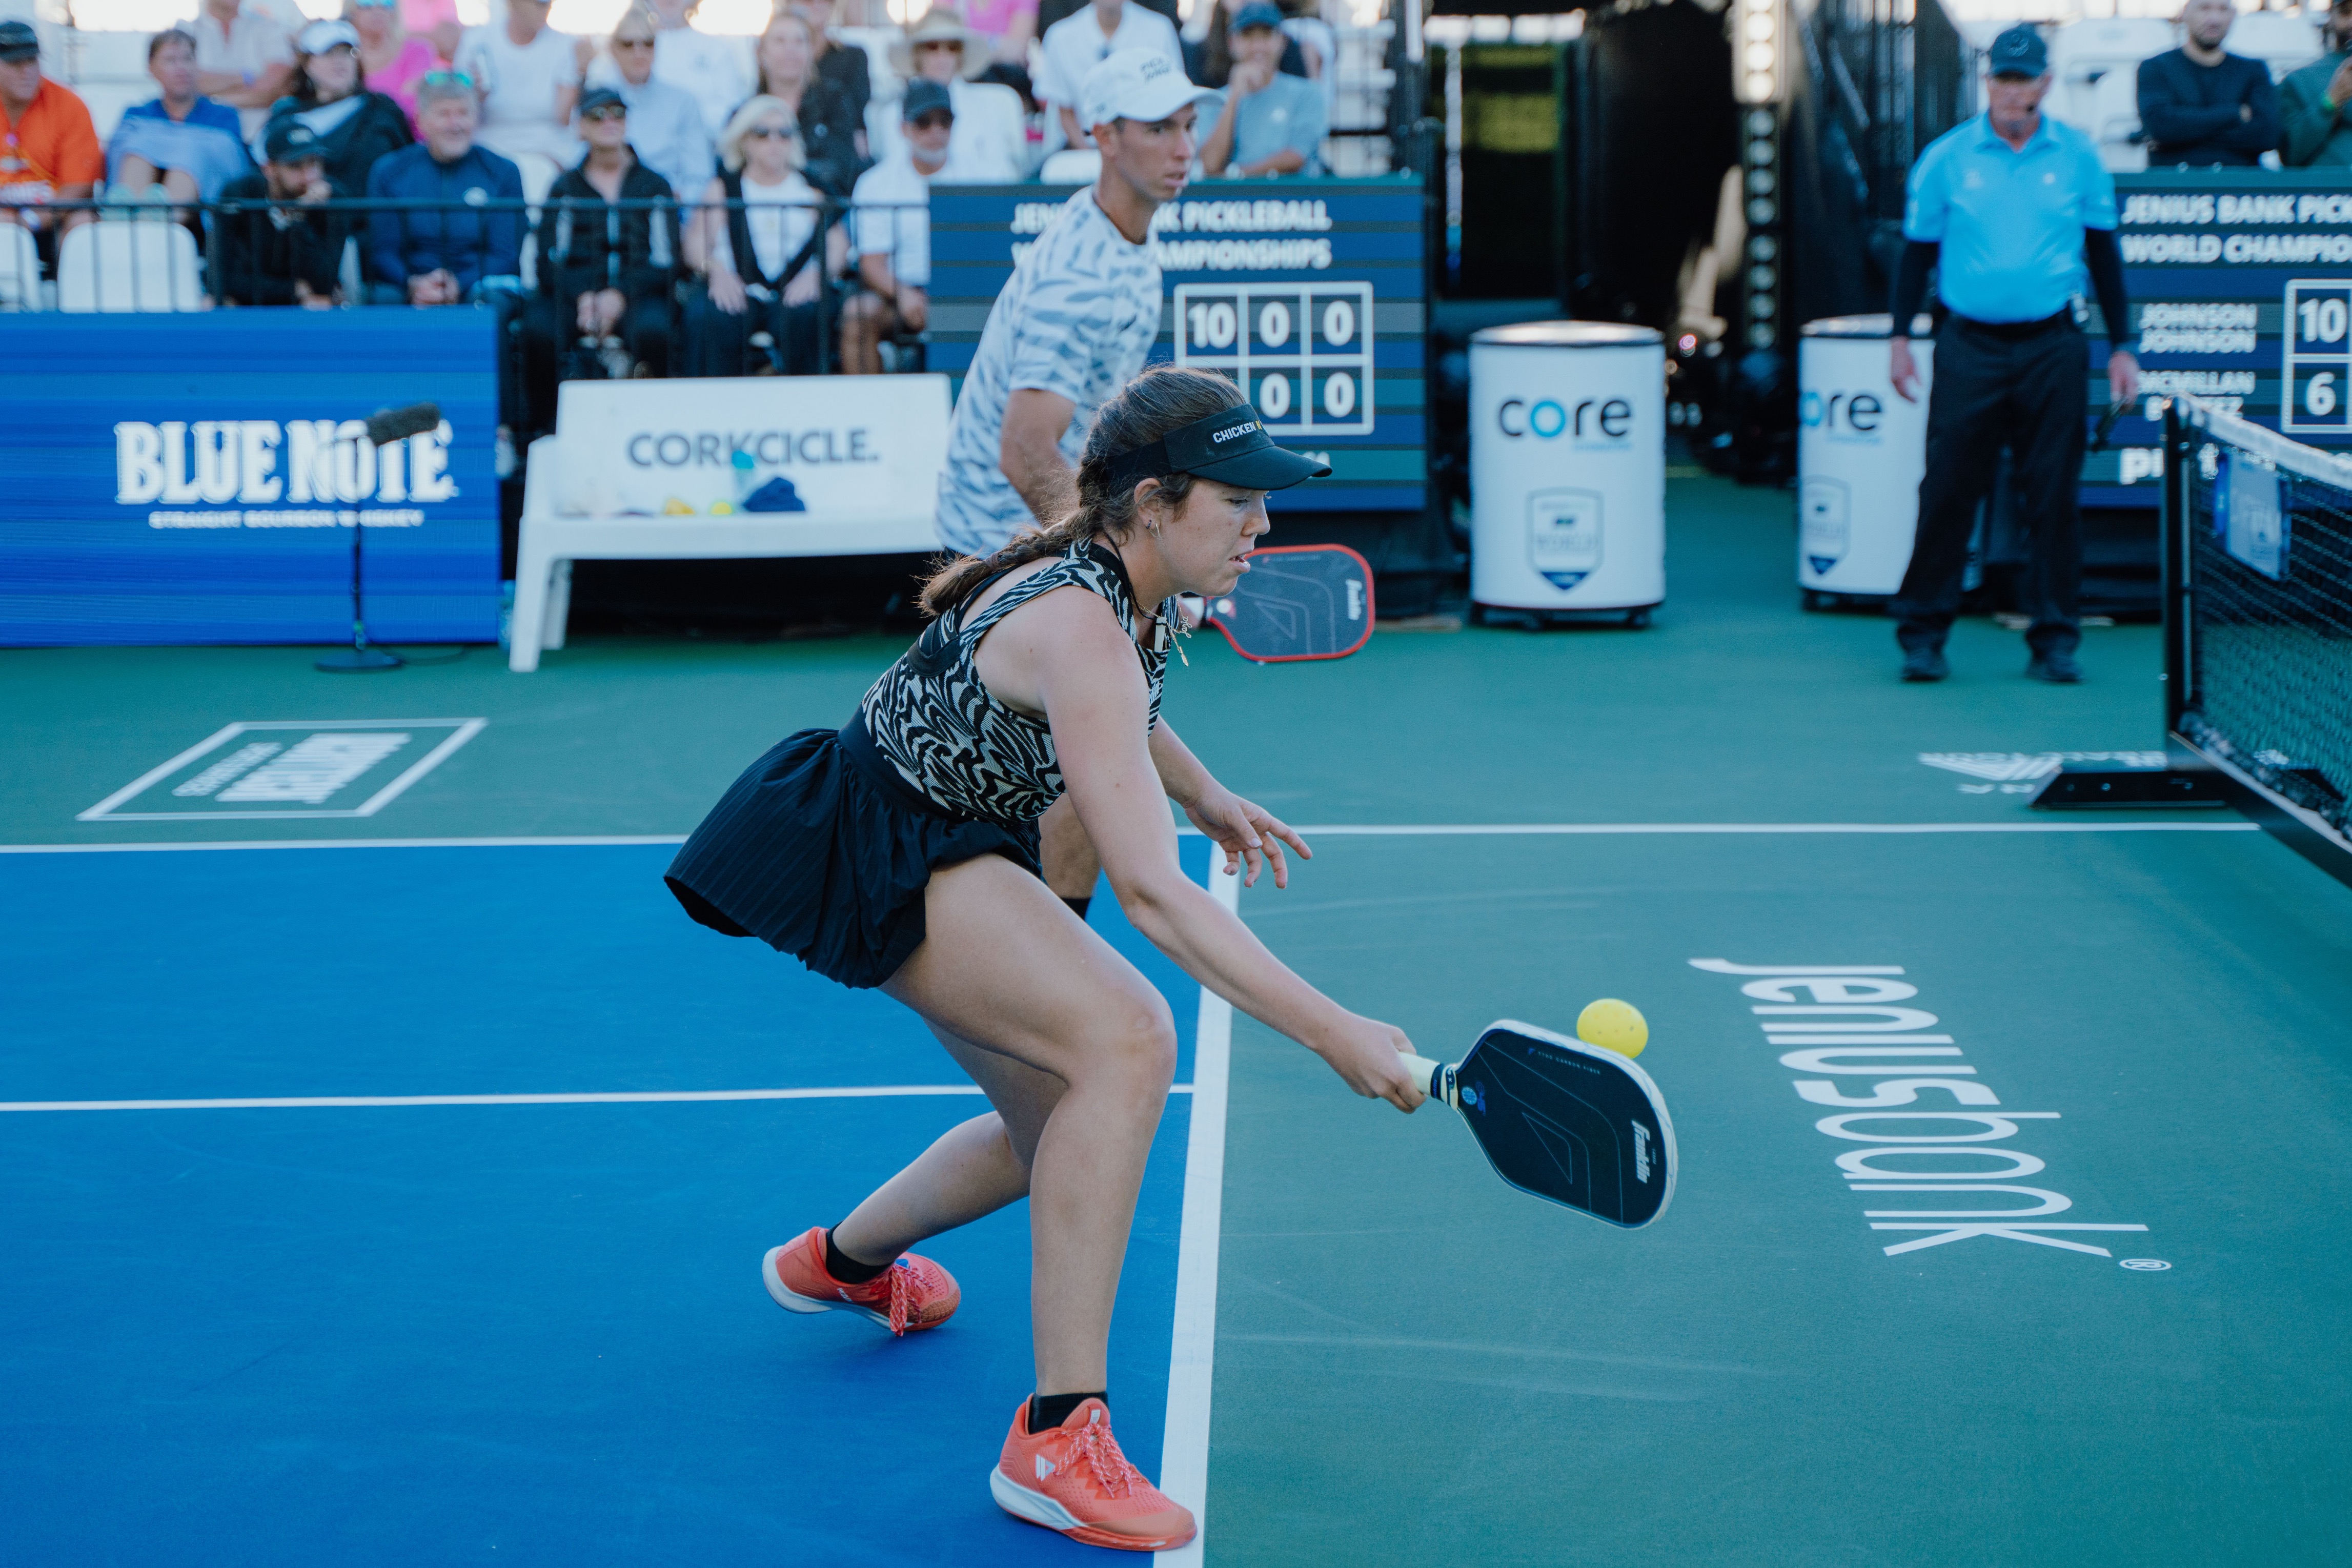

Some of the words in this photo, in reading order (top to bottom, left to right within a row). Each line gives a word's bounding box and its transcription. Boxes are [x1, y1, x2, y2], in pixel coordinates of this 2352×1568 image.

[1183, 200, 1332, 232] PICKLEBALL
[2121, 195, 2215, 224] JENIUS
[2217, 194, 2296, 224] BANK
[2121, 234, 2223, 263] WORLD
[2223, 234, 2352, 263] CHAMPIO
[1187, 302, 1236, 349] 10
[1260, 301, 1290, 348] 0
[1324, 300, 1354, 346] 0
[2139, 303, 2257, 329] JOHNSON
[2299, 298, 2347, 343] 10
[2139, 328, 2256, 353] JOHNSON
[1260, 373, 1290, 419] 0
[1324, 372, 1355, 418] 0
[2305, 372, 2336, 416] 6
[1212, 421, 1256, 443] CHICKEN
[1498, 398, 1632, 438] core
[114, 420, 282, 505] BLUE
[628, 429, 880, 467] CORKCICLE.
[1632, 1119, 1650, 1184] Franklin
